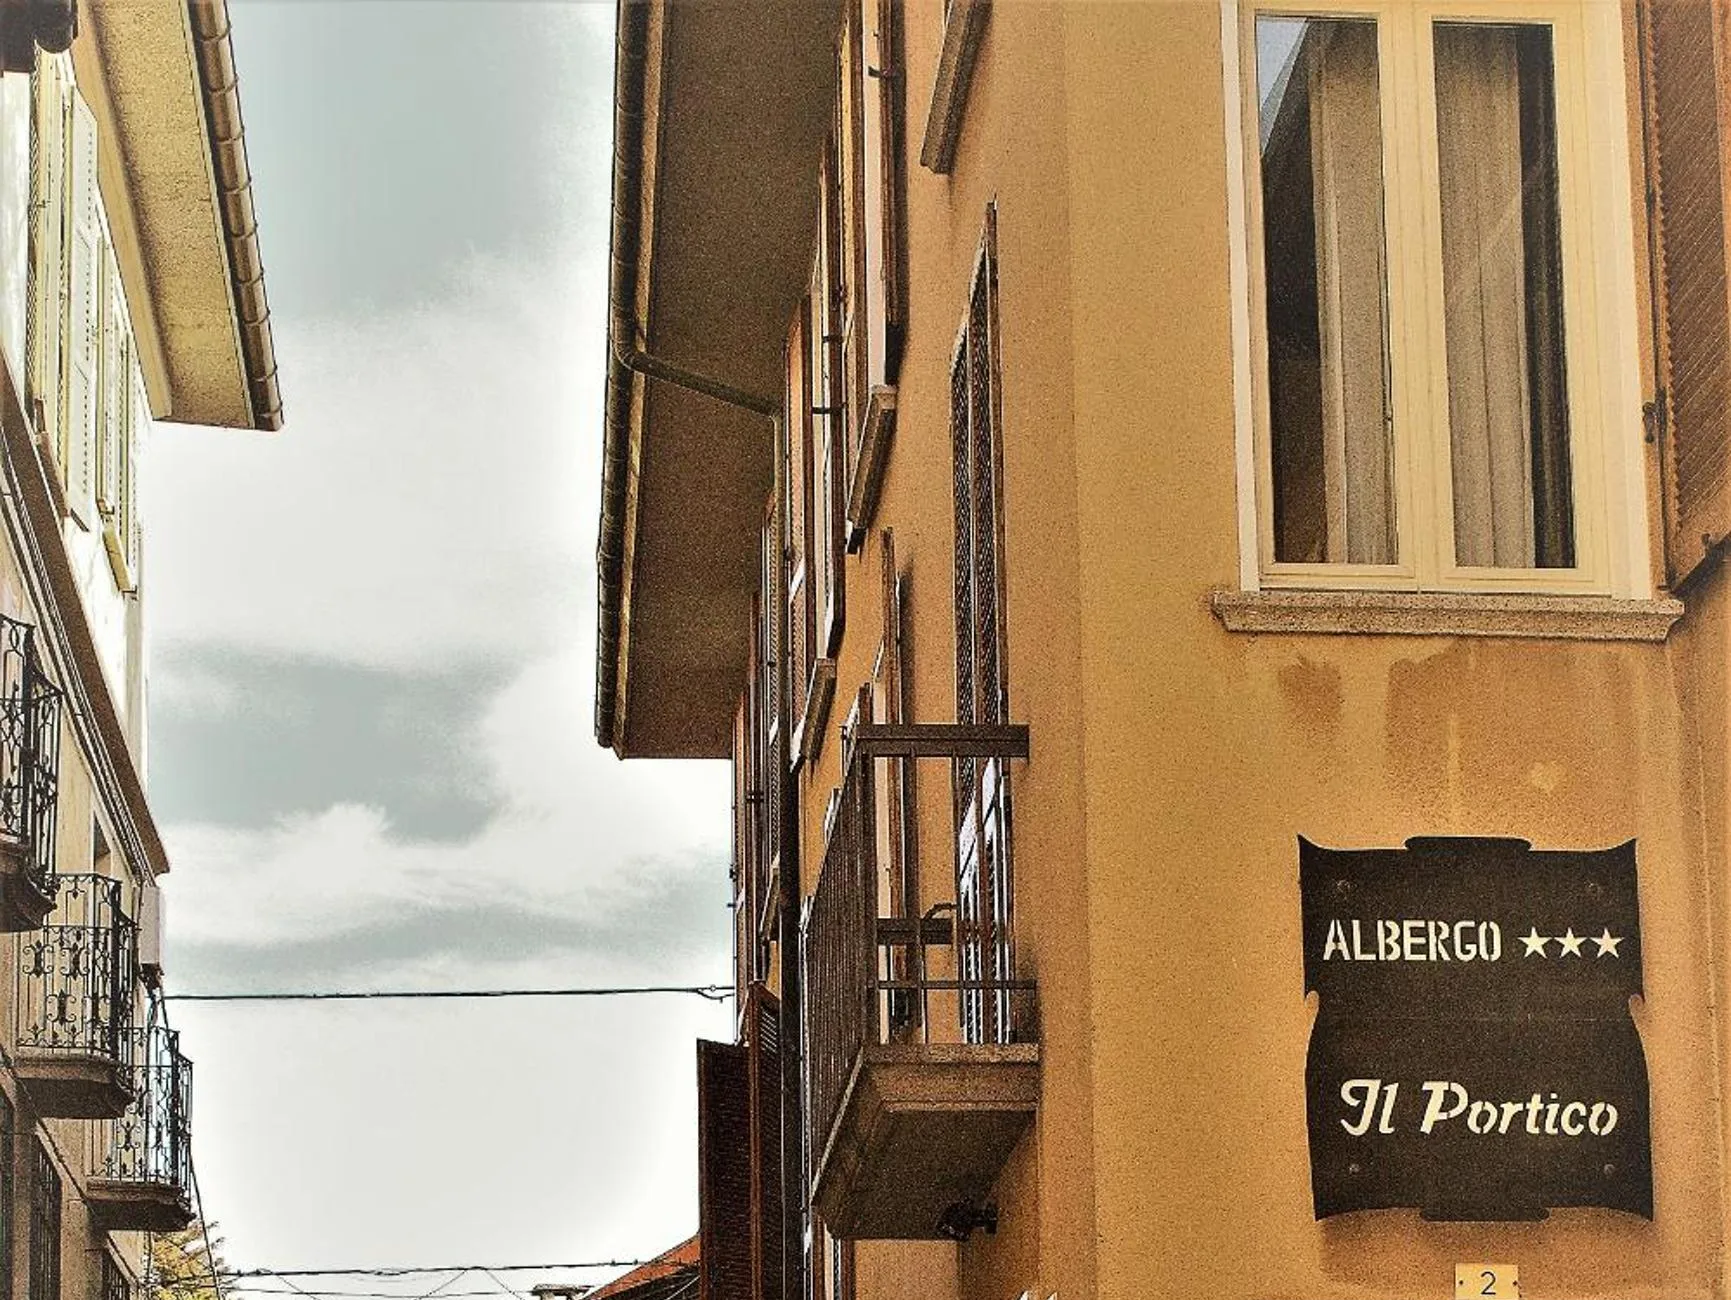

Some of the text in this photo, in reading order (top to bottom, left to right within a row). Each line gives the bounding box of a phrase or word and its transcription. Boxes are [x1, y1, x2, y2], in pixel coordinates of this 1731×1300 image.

[1323, 919, 1501, 961] ALBERGO
[1340, 1079, 1618, 1136] Il Portico
[1480, 1271, 1496, 1295] 2
